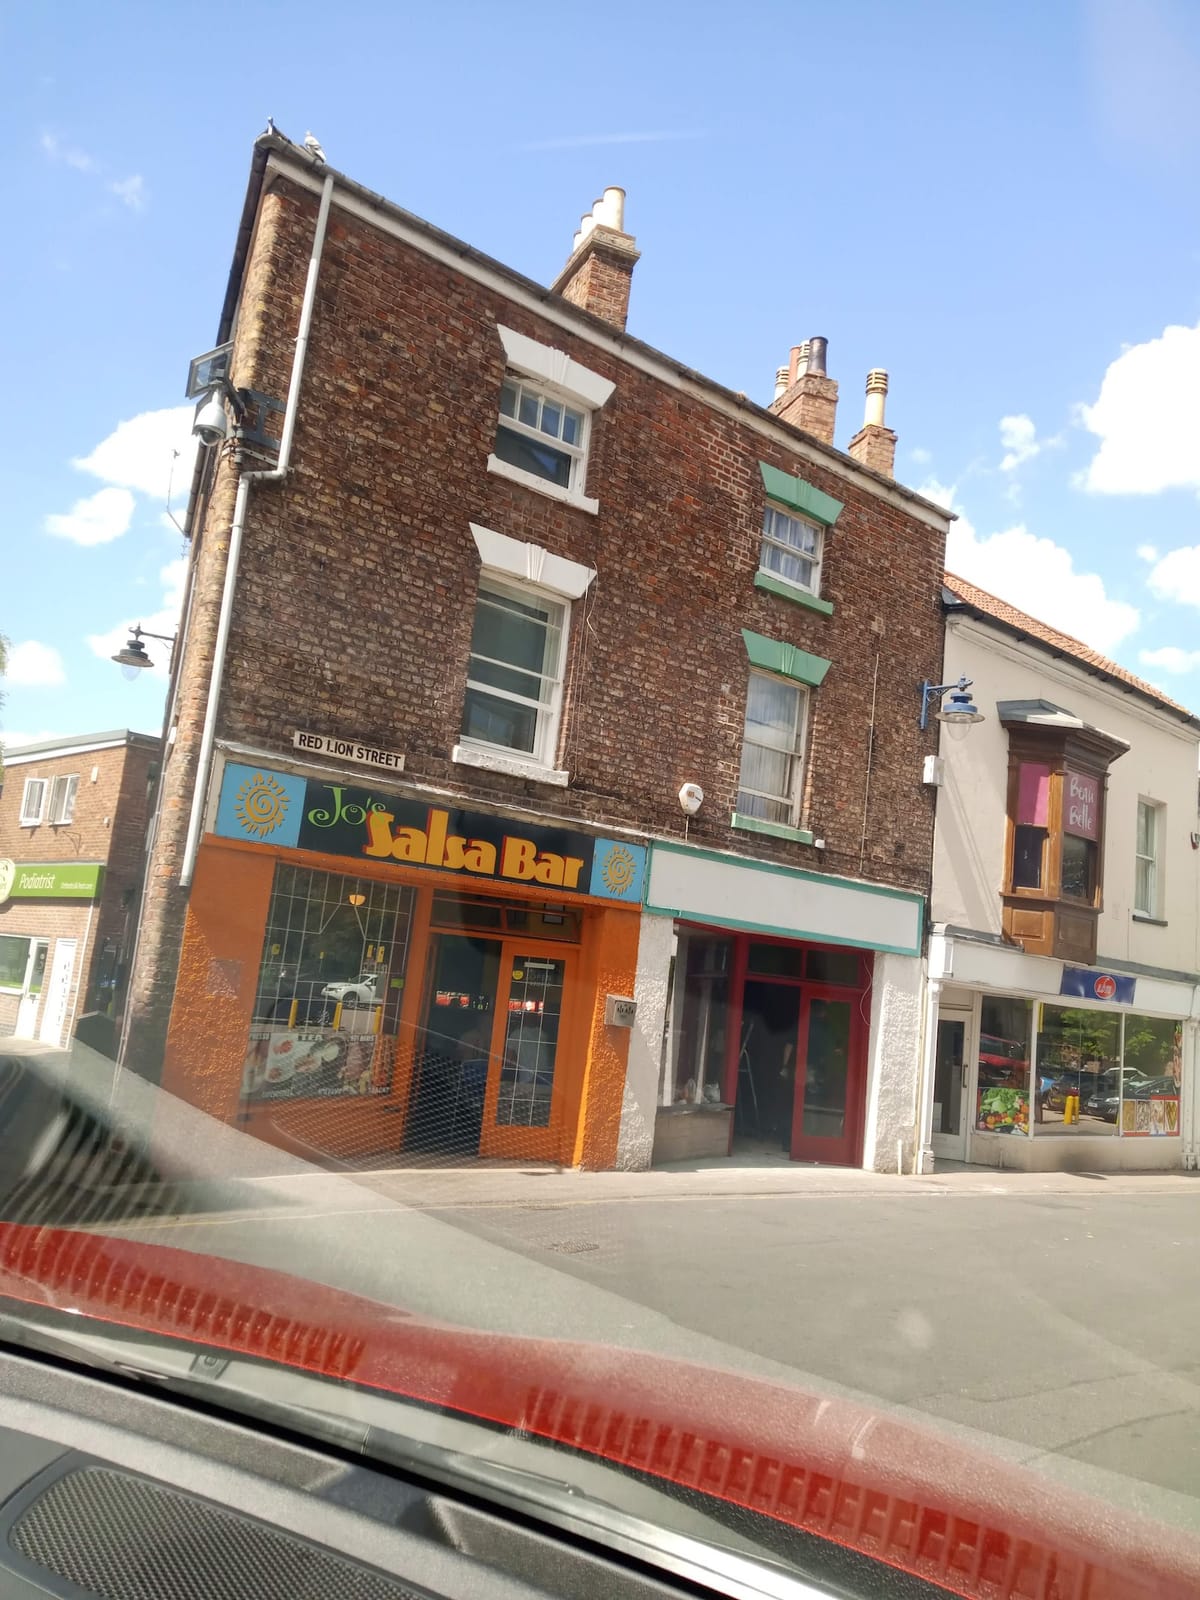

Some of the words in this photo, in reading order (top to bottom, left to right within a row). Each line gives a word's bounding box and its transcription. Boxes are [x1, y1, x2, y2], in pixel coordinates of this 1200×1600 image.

[298, 734, 323, 750] RED
[326, 739, 354, 758] LION
[356, 747, 402, 768] STREET
[307, 784, 388, 829] Jo's
[363, 808, 498, 876] Salsa
[499, 835, 585, 890] Bar
[18, 873, 56, 889] Podiatrist
